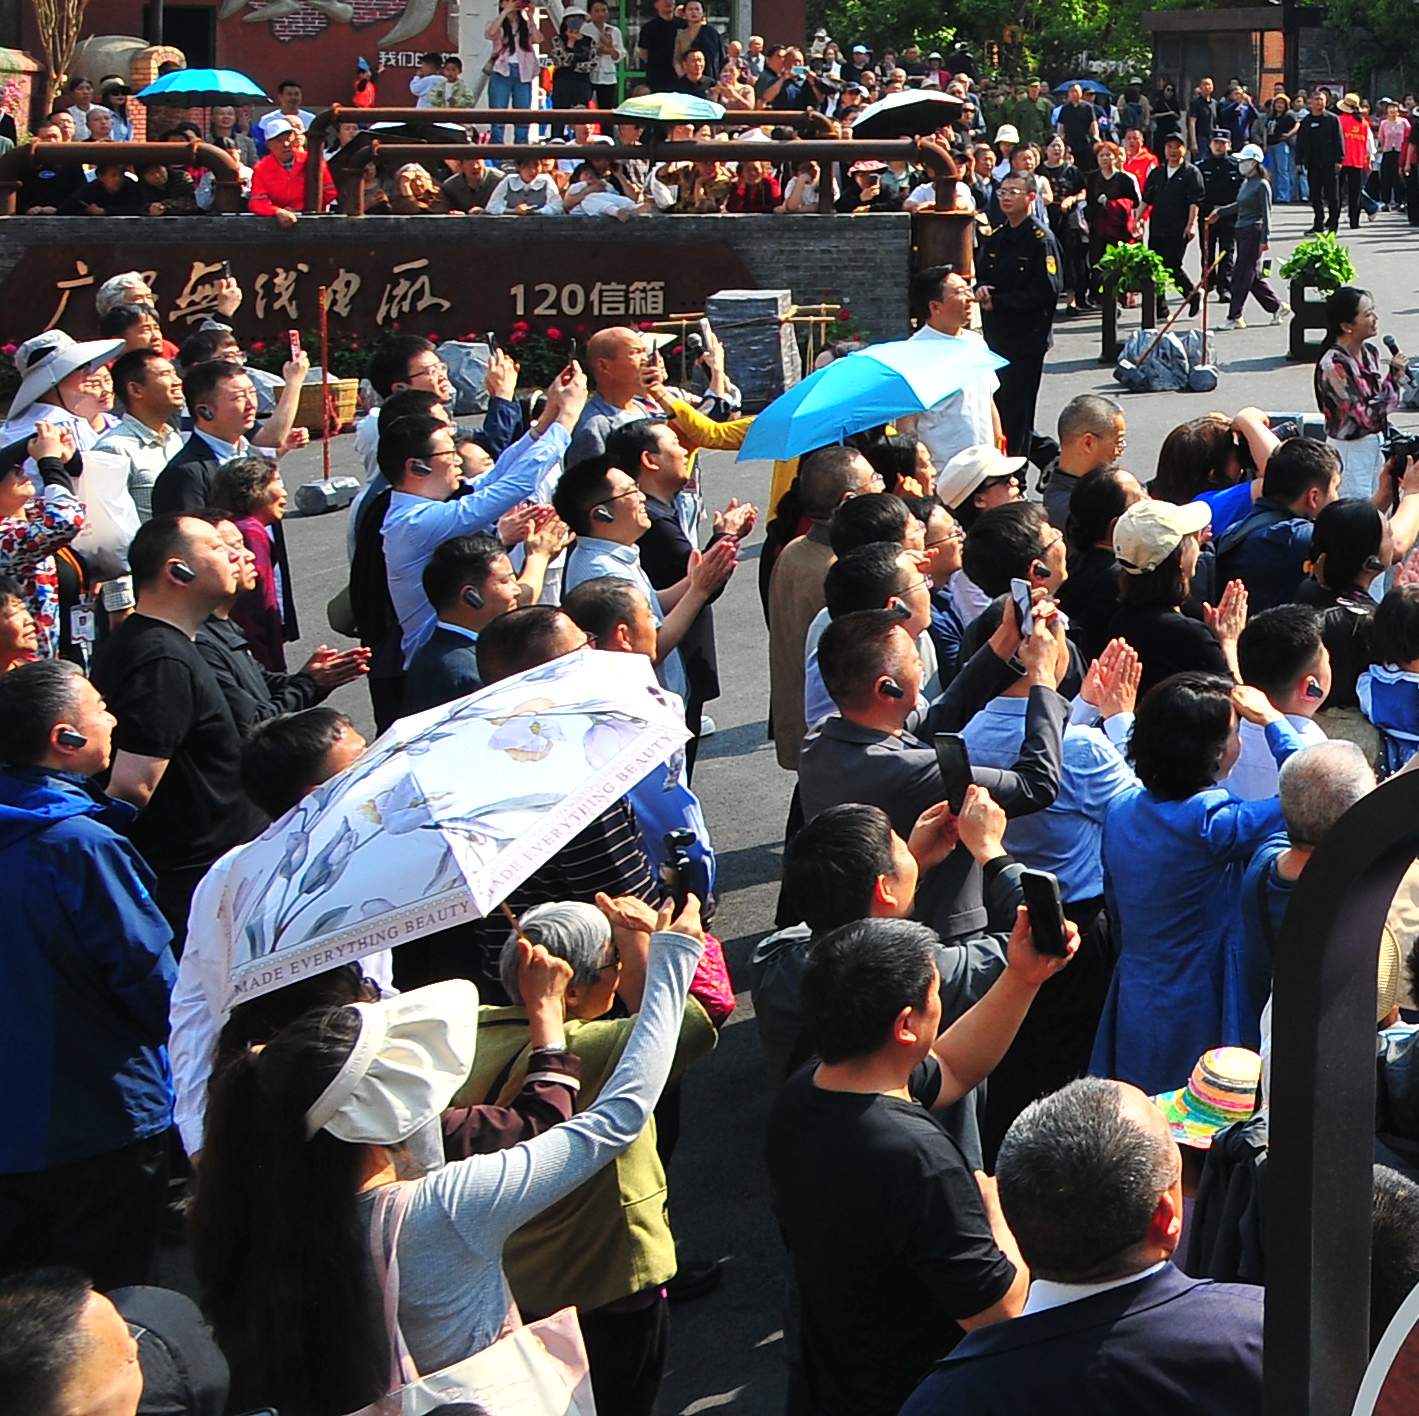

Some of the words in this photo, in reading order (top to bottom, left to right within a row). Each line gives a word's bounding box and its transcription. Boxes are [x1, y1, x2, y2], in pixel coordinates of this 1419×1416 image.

[510, 282, 665, 316] 120信箱
[523, 782, 616, 862] EVERYTHING
[615, 733, 674, 782] BEAUTY
[233, 967, 284, 995] MADE
[290, 926, 399, 975] EVERYTHING
[404, 900, 470, 934] BEAUTY
